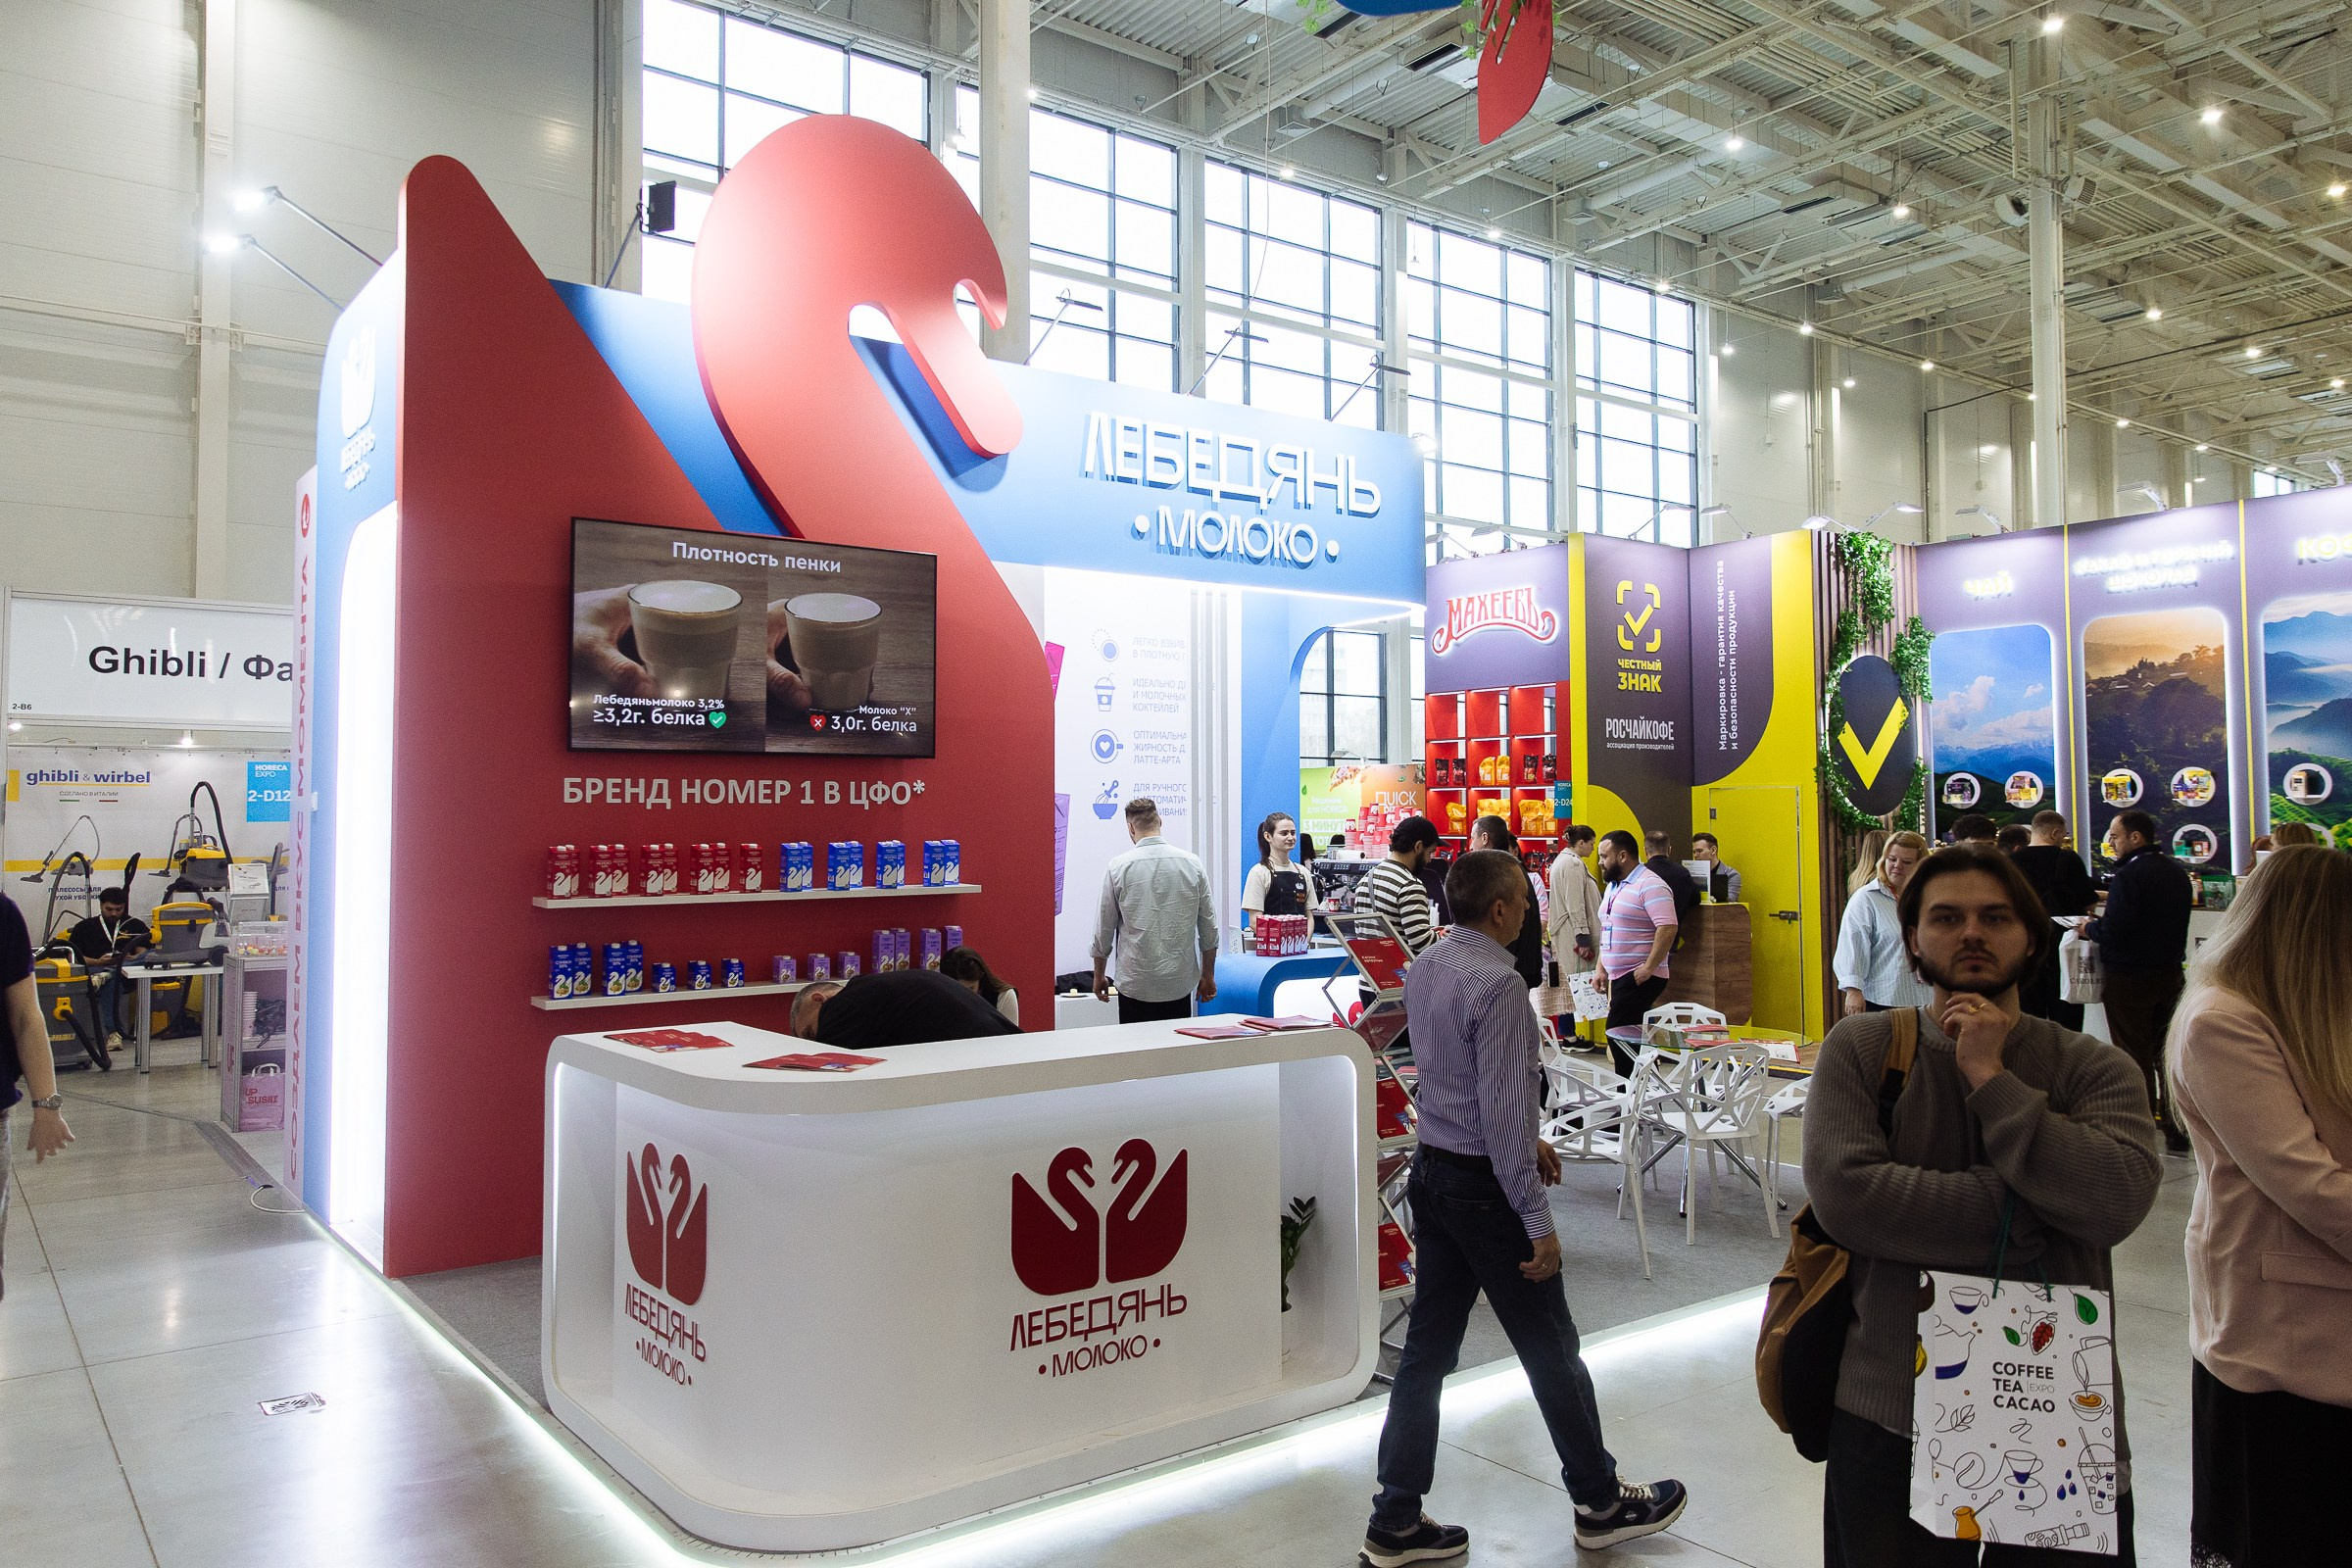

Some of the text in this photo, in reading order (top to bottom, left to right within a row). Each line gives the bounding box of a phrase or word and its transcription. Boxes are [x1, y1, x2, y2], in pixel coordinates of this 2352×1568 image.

[1083, 411, 1381, 514] ЛЕБЕДЯНЬ
[1157, 504, 1319, 566] МОЛОКО
[672, 541, 841, 573] Плотность пенки
[1963, 569, 2011, 595] ЧАЙ
[1432, 586, 1556, 655] МАХЕЕВЪ
[1729, 590, 1739, 655] продукции
[1133, 637, 1158, 647] ЛЕГКО
[1717, 615, 1727, 668] гарантия
[88, 646, 293, 681] Ghibli / Фа
[1141, 650, 1181, 661] ПЛОТНУЮ
[1617, 658, 1662, 671] ЧЕСТНЫЙ
[297, 554, 309, 798] МОМЕНТА
[1133, 678, 1176, 689] ИДЕАЛЬНО
[1617, 672, 1662, 693] ЗНАК
[594, 693, 725, 711] Лебедяньмолоко 3,2%
[1141, 691, 1187, 701] МОЛОЧНЫХ
[1729, 658, 1739, 740] безопасности
[858, 705, 898, 716] Молоко
[1133, 703, 1180, 712] КОКТЕЙЛЕЙ
[1718, 676, 1728, 751] Маркировка
[651, 709, 706, 727] белка
[831, 716, 917, 733] 3,0г. белка
[1605, 716, 1675, 742] РОСЧАЙКОФЕ
[1134, 743, 1178, 753] ЖИРНОСТЬ
[1636, 742, 1676, 751] производителей
[1134, 756, 1181, 764] ЛАТТЕ-АРТА
[26, 769, 78, 786] ghibli
[94, 771, 151, 783] wirbel
[248, 790, 292, 803] 2-D12
[563, 777, 672, 810] БРЕНД
[680, 778, 792, 806] НОМЕР
[800, 780, 815, 805] 1
[824, 780, 841, 805] В
[1133, 783, 1151, 792] ДЛЯ
[247, 1096, 278, 1104] SUSHI
[624, 1282, 708, 1363] ЛЕБЕДЯНЬ
[1009, 1283, 1188, 1352] ЛЕБЕДЯНЬ
[641, 1337, 687, 1386] МОЛОКО
[1052, 1334, 1149, 1378] МОЛОКО
[1992, 1361, 2054, 1380] COFFEE
[1992, 1378, 2055, 1395] TEA EXPO
[1993, 1395, 2056, 1413] CACAO
